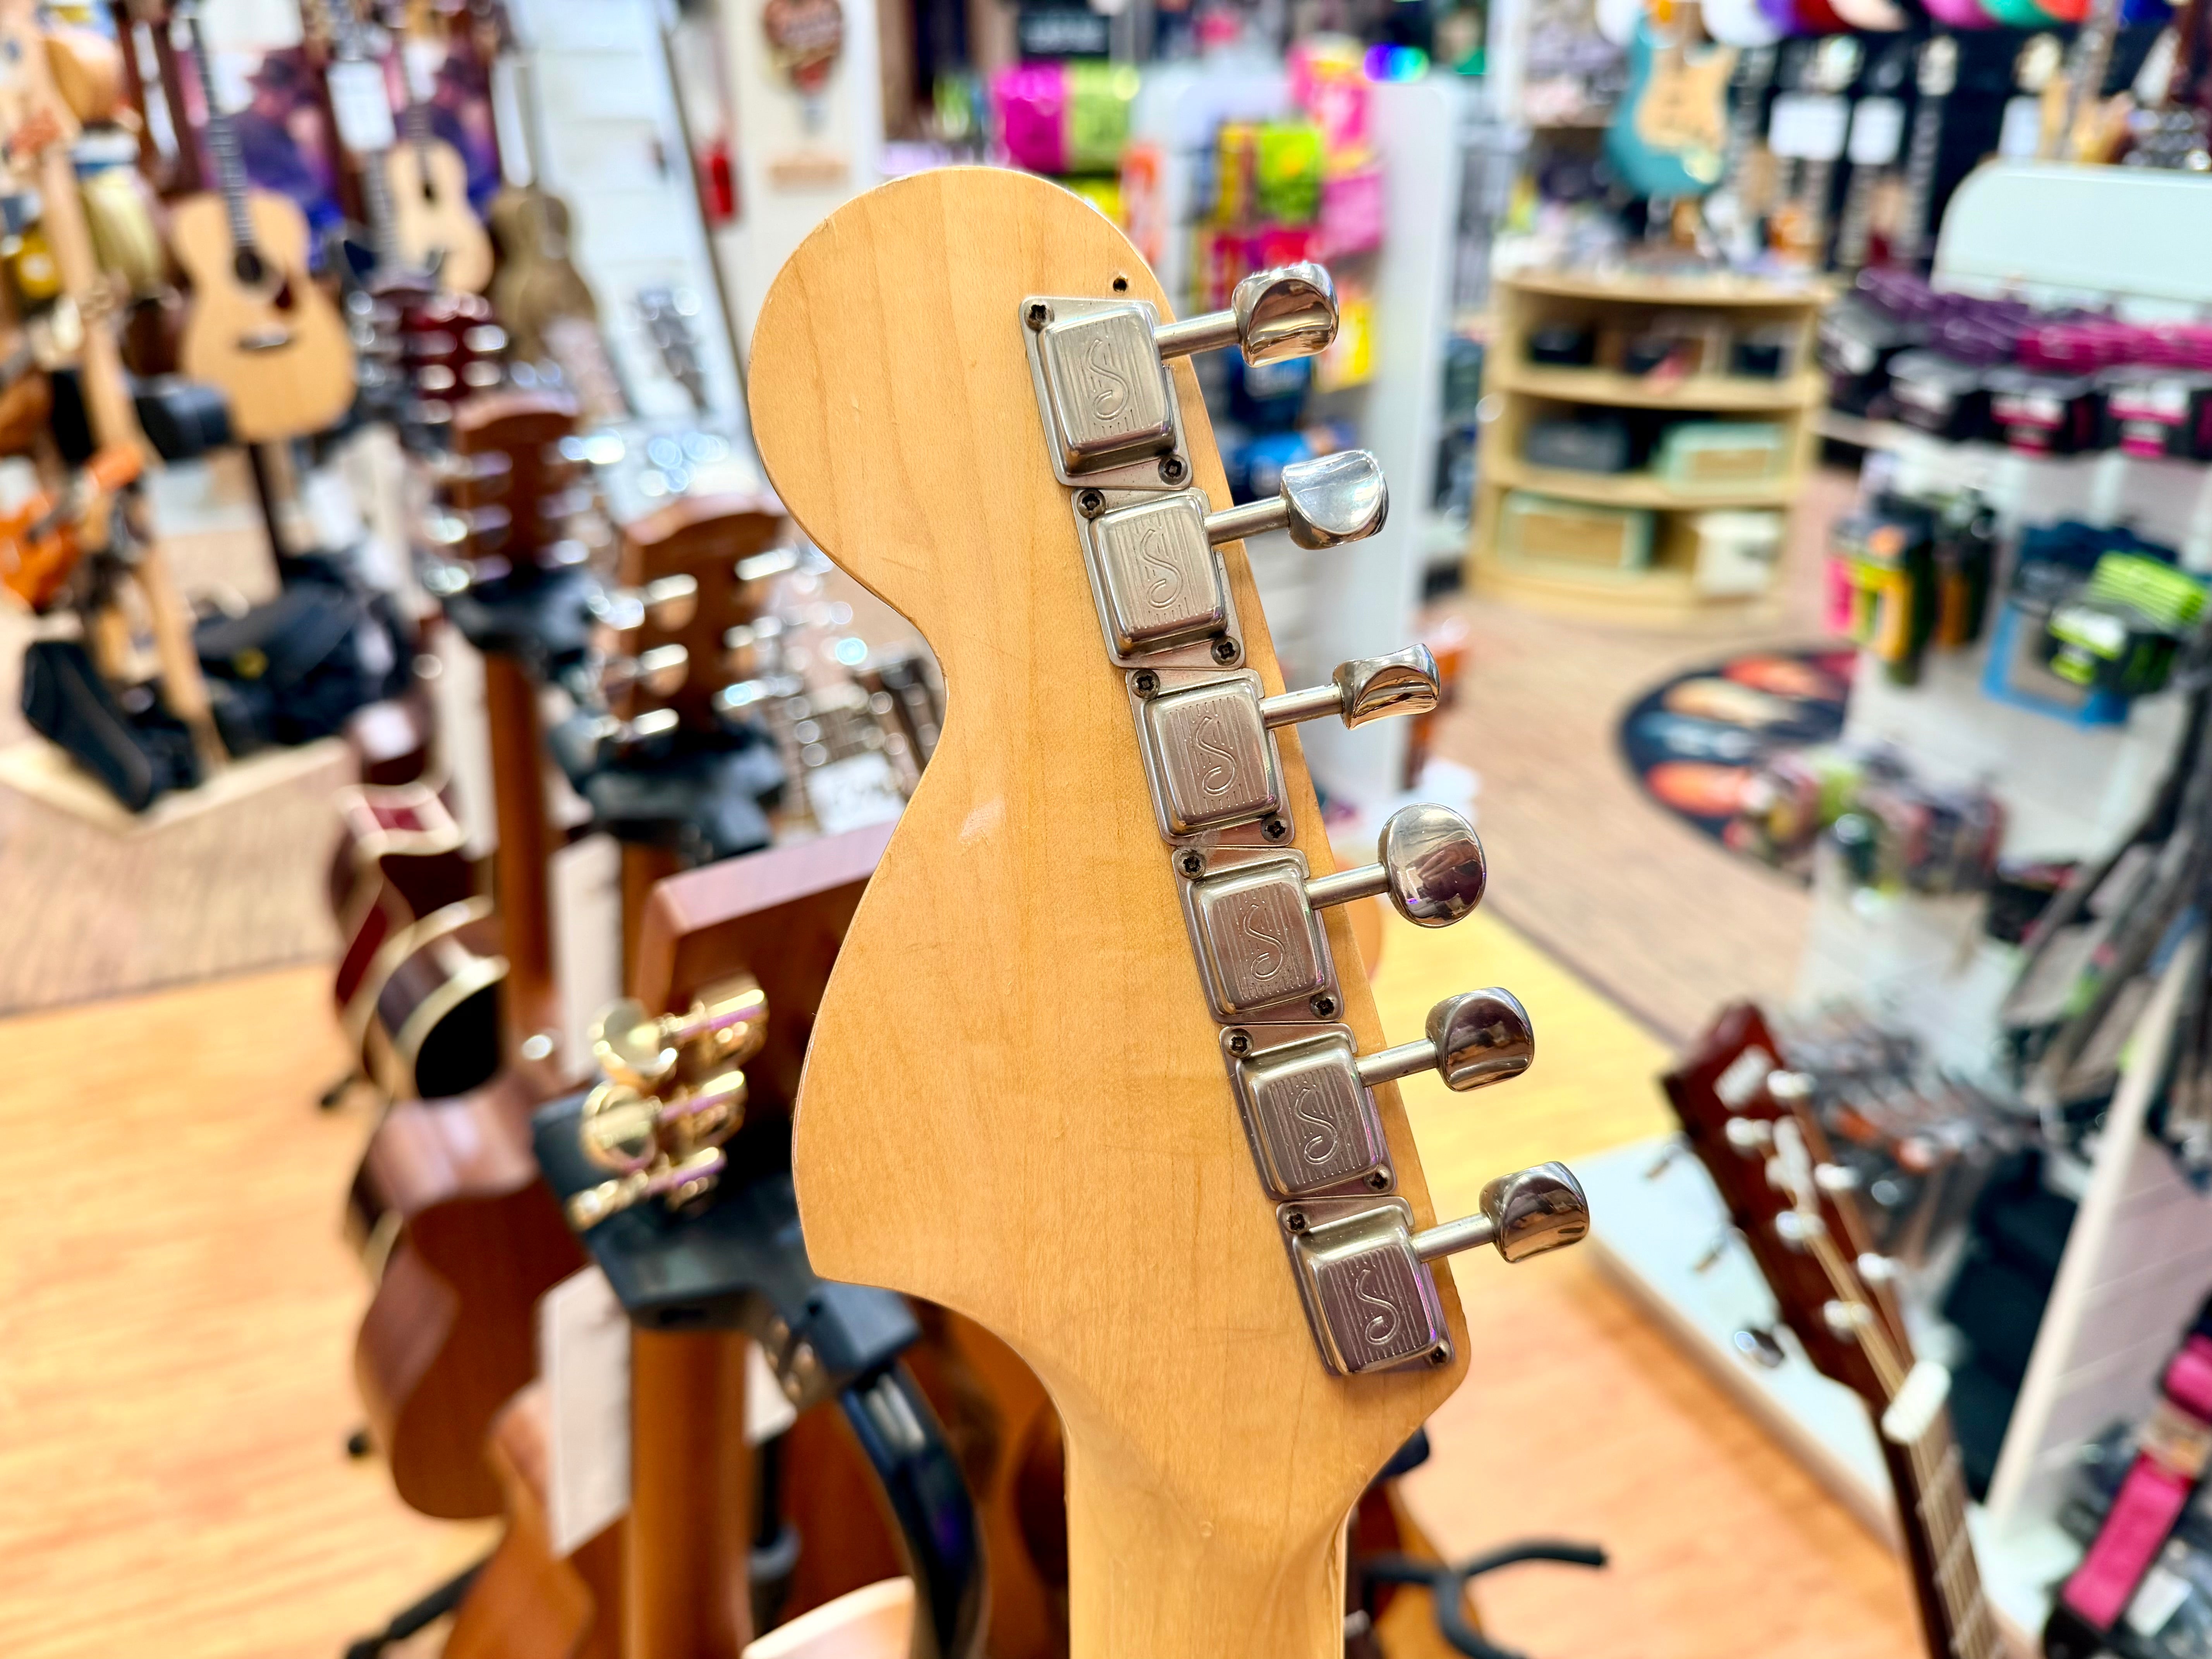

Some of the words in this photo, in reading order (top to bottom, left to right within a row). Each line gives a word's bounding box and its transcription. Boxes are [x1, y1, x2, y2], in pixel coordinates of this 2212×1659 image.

[1087, 339, 1129, 420] S
[1140, 529, 1183, 610] S
[1196, 716, 1237, 796] S
[1243, 904, 1285, 981] S
[1295, 1087, 1338, 1164] S
[1355, 1269, 1400, 1345] S
